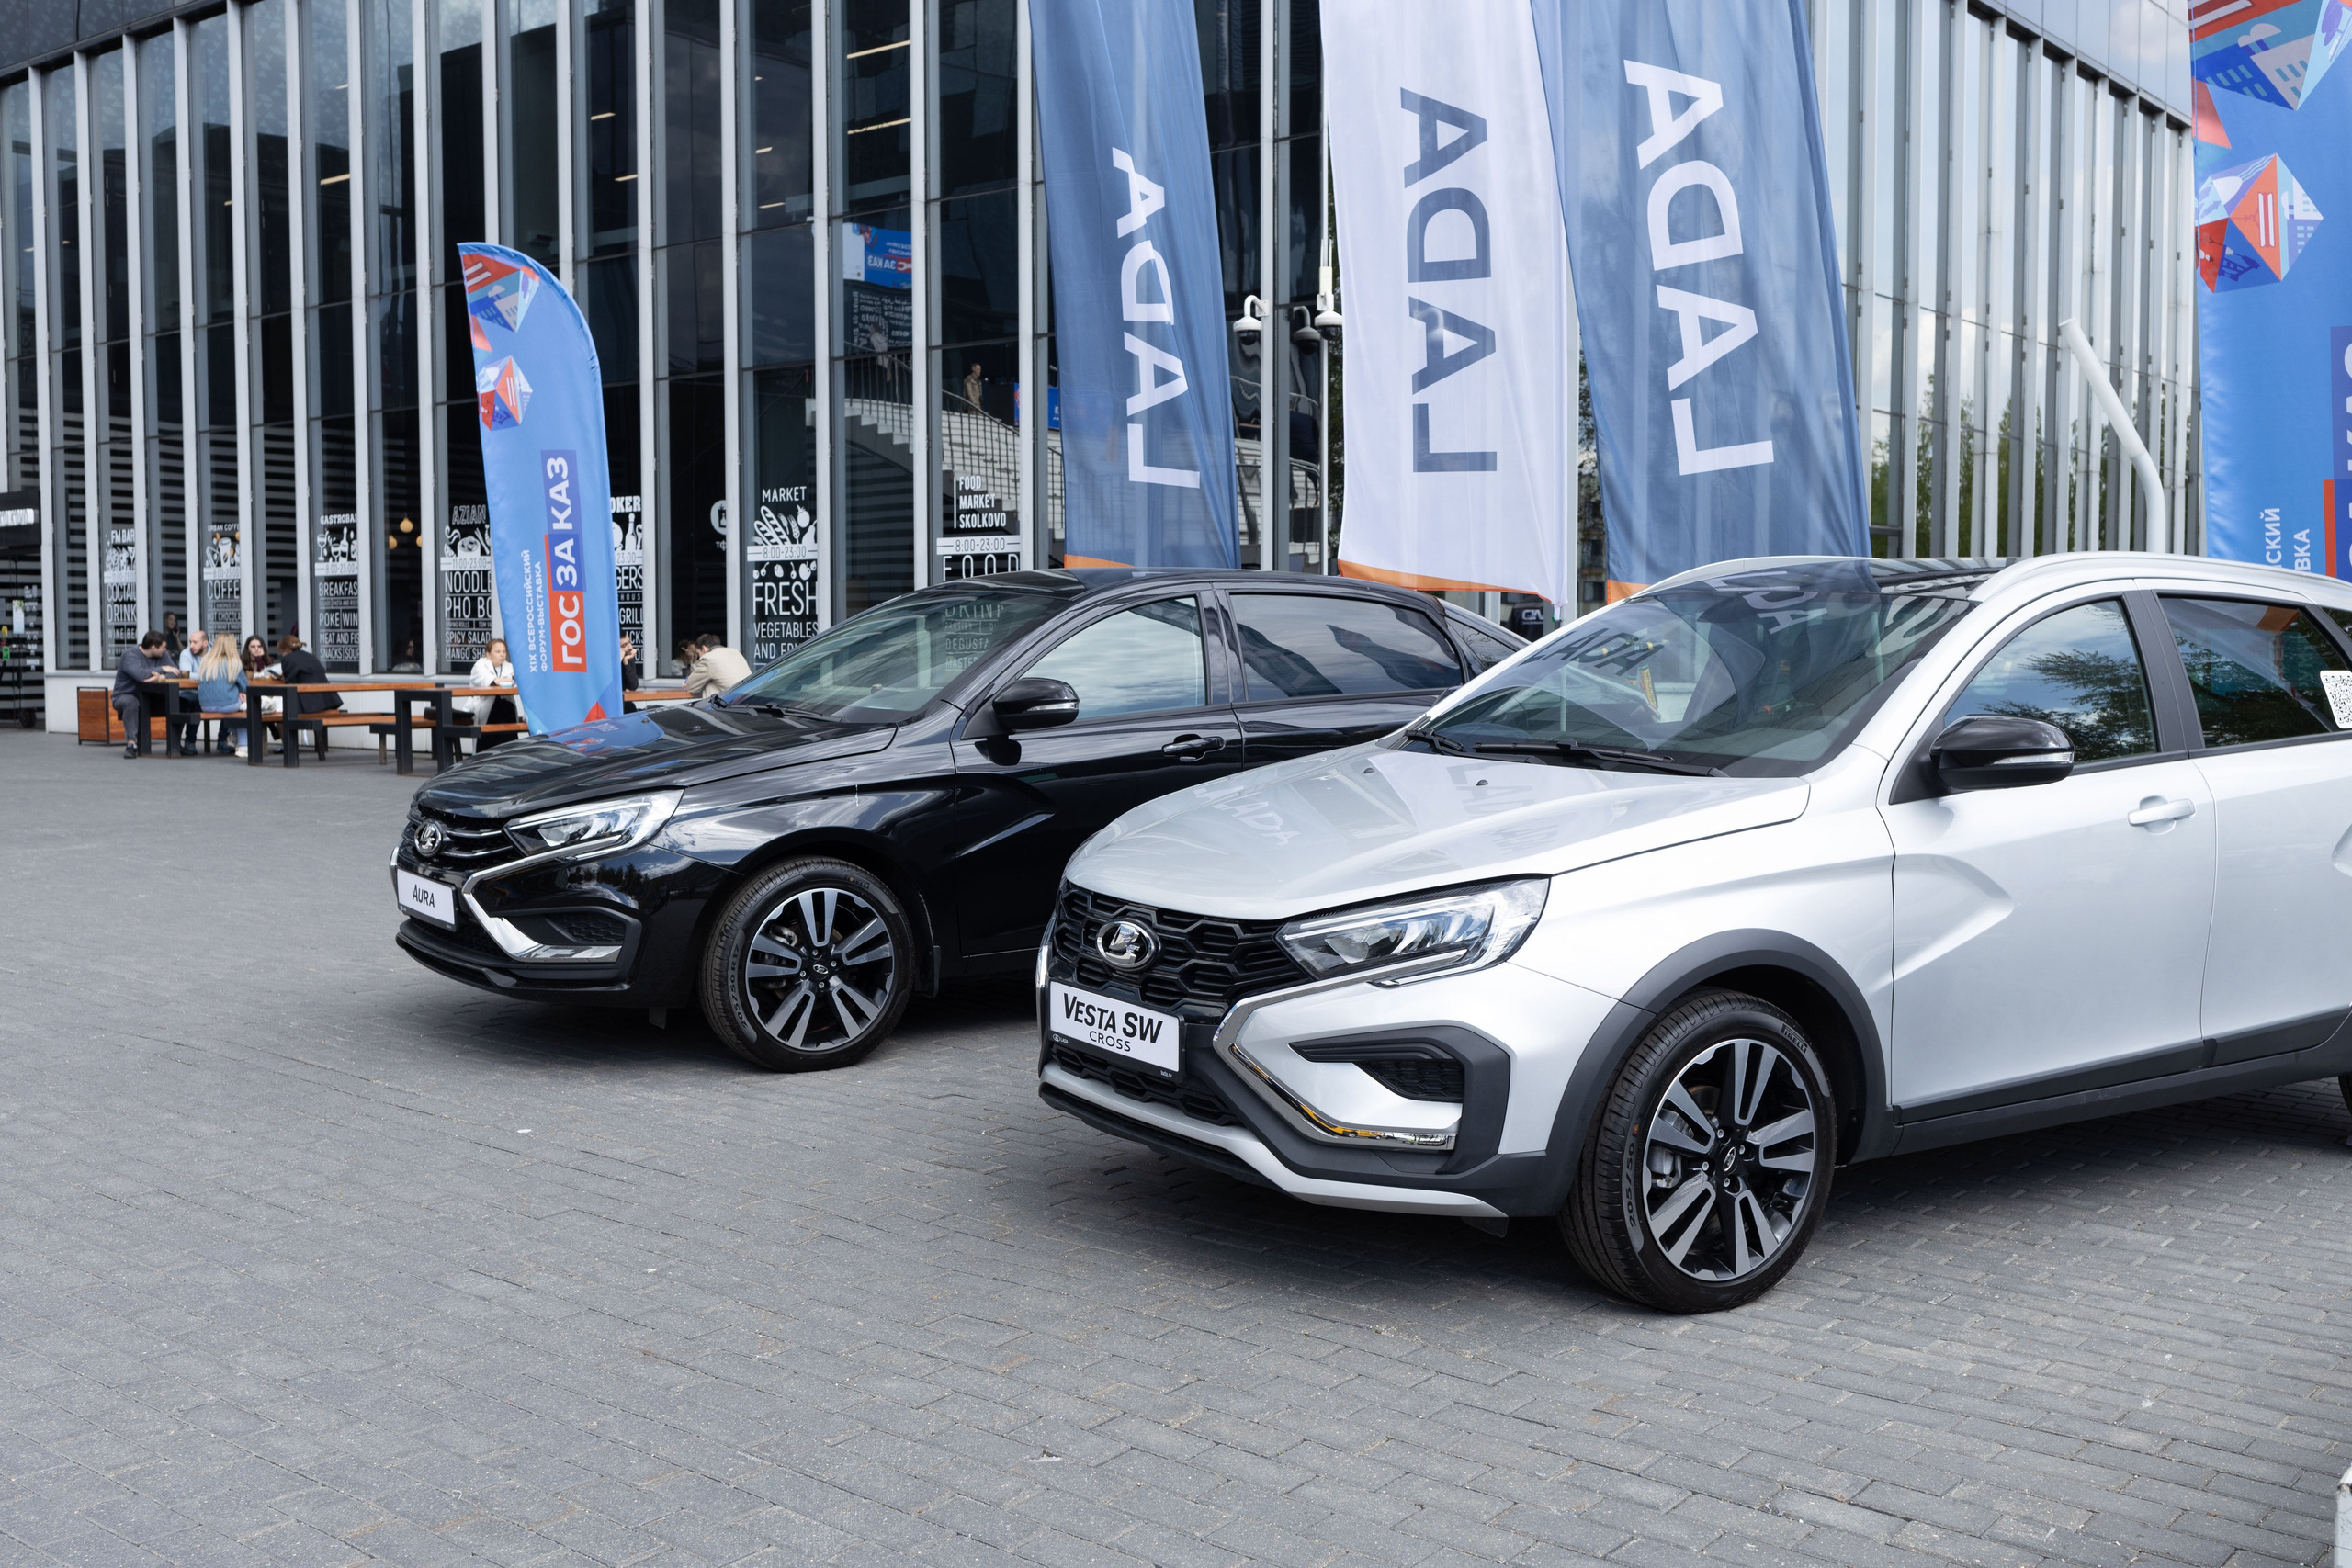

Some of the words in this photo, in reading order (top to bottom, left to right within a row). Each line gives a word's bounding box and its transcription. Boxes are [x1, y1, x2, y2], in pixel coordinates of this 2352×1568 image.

[959, 475, 982, 491] FOOD
[762, 486, 807, 502] MARKET
[959, 493, 996, 510] MARKET
[959, 512, 1007, 529] SKOLKOVO
[763, 546, 807, 559] 8:00-23:00
[956, 537, 1006, 552] 8:00-23:00
[521, 549, 537, 652] ВСЕРОССИЙСКИЙ
[752, 581, 818, 616] FRESH
[445, 596, 471, 619] PHO
[319, 612, 340, 626] POKE
[534, 561, 548, 672] ФОРУМ-ВЫСТАВКА
[319, 632, 335, 644] MEAT
[336, 632, 349, 644] AND
[445, 631, 466, 644] SPICY
[754, 621, 819, 638] VEGETABLES
[445, 647, 470, 660] MANGO
[753, 642, 776, 660] AND
[529, 656, 537, 673] XIX
[412, 884, 435, 908] AURA
[1063, 992, 1117, 1034] VESTA
[1122, 1012, 1163, 1044] SW
[1089, 1031, 1131, 1052] CROSS
[1781, 1023, 1808, 1054] PIRELLI
